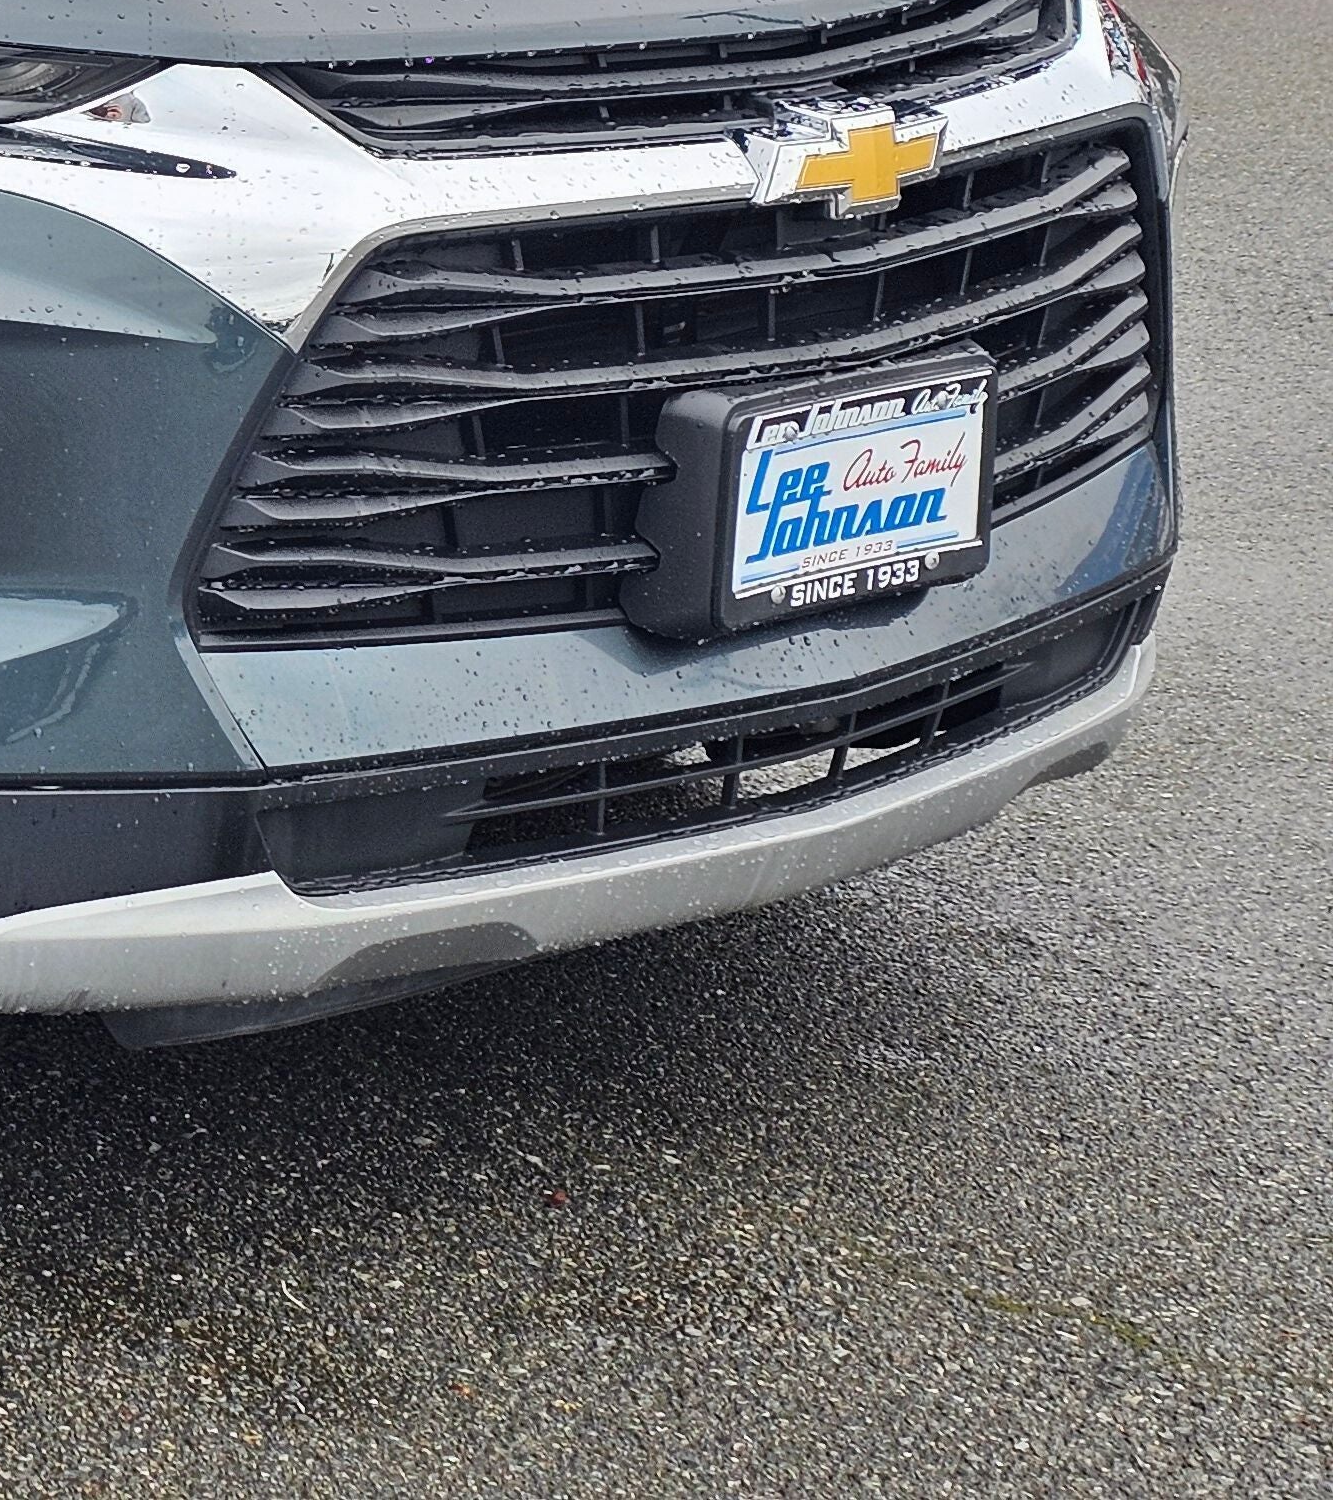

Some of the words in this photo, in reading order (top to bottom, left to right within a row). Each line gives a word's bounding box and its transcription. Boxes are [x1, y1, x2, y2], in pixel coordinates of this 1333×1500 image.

[797, 398, 907, 439] Johnson
[745, 448, 833, 516] Lee
[843, 448, 897, 492] Auto
[899, 431, 968, 488] Family
[744, 486, 948, 565] Johnson
[801, 547, 849, 569] SINCE
[854, 539, 894, 558] 1933
[789, 572, 858, 607] SINCE
[865, 559, 921, 592] 1933
